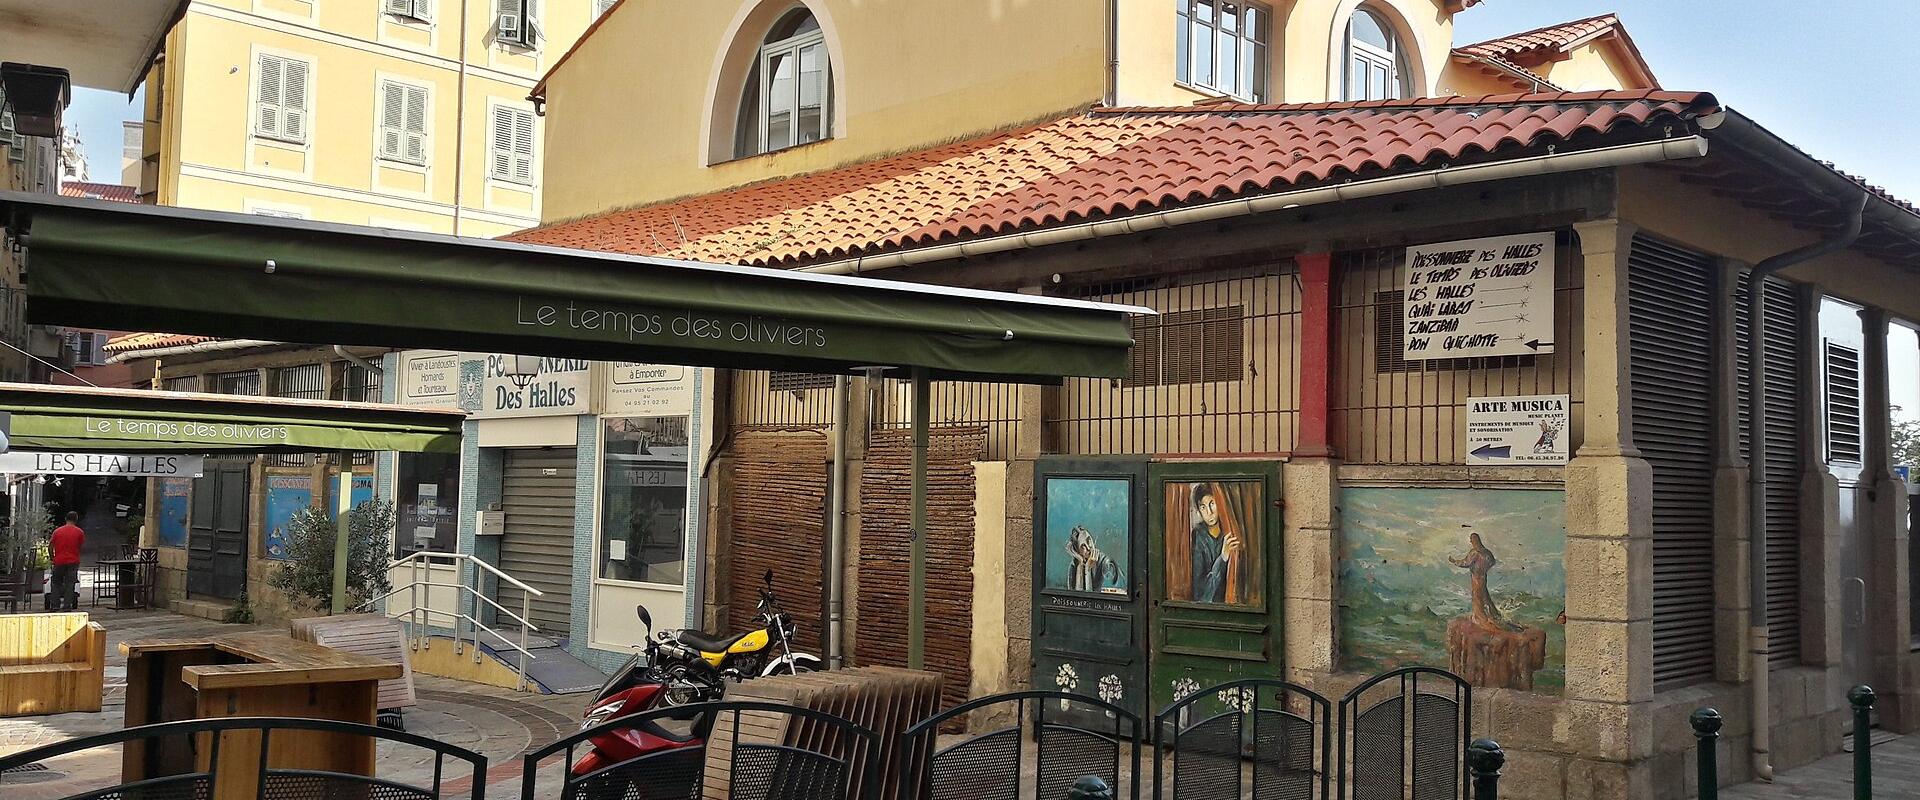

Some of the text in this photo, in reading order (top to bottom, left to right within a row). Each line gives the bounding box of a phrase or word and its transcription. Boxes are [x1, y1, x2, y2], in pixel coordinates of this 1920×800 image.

[1477, 250, 1496, 262] DES
[1502, 244, 1543, 259] HALLES
[1410, 272, 1422, 284] LE
[1426, 267, 1462, 283] TEMPS
[1470, 267, 1489, 279] DES
[1408, 283, 1475, 301] LES HALLES
[1438, 300, 1475, 315] LARGO
[517, 296, 825, 346] Le temps des oliviers
[1408, 337, 1430, 351] DON
[636, 369, 666, 378] Emporter
[496, 381, 576, 410] Des Halles
[1473, 400, 1562, 413] ARTE MUSICA
[86, 416, 287, 439] Le temps des oliviers
[35, 453, 177, 474] LES HALLES
